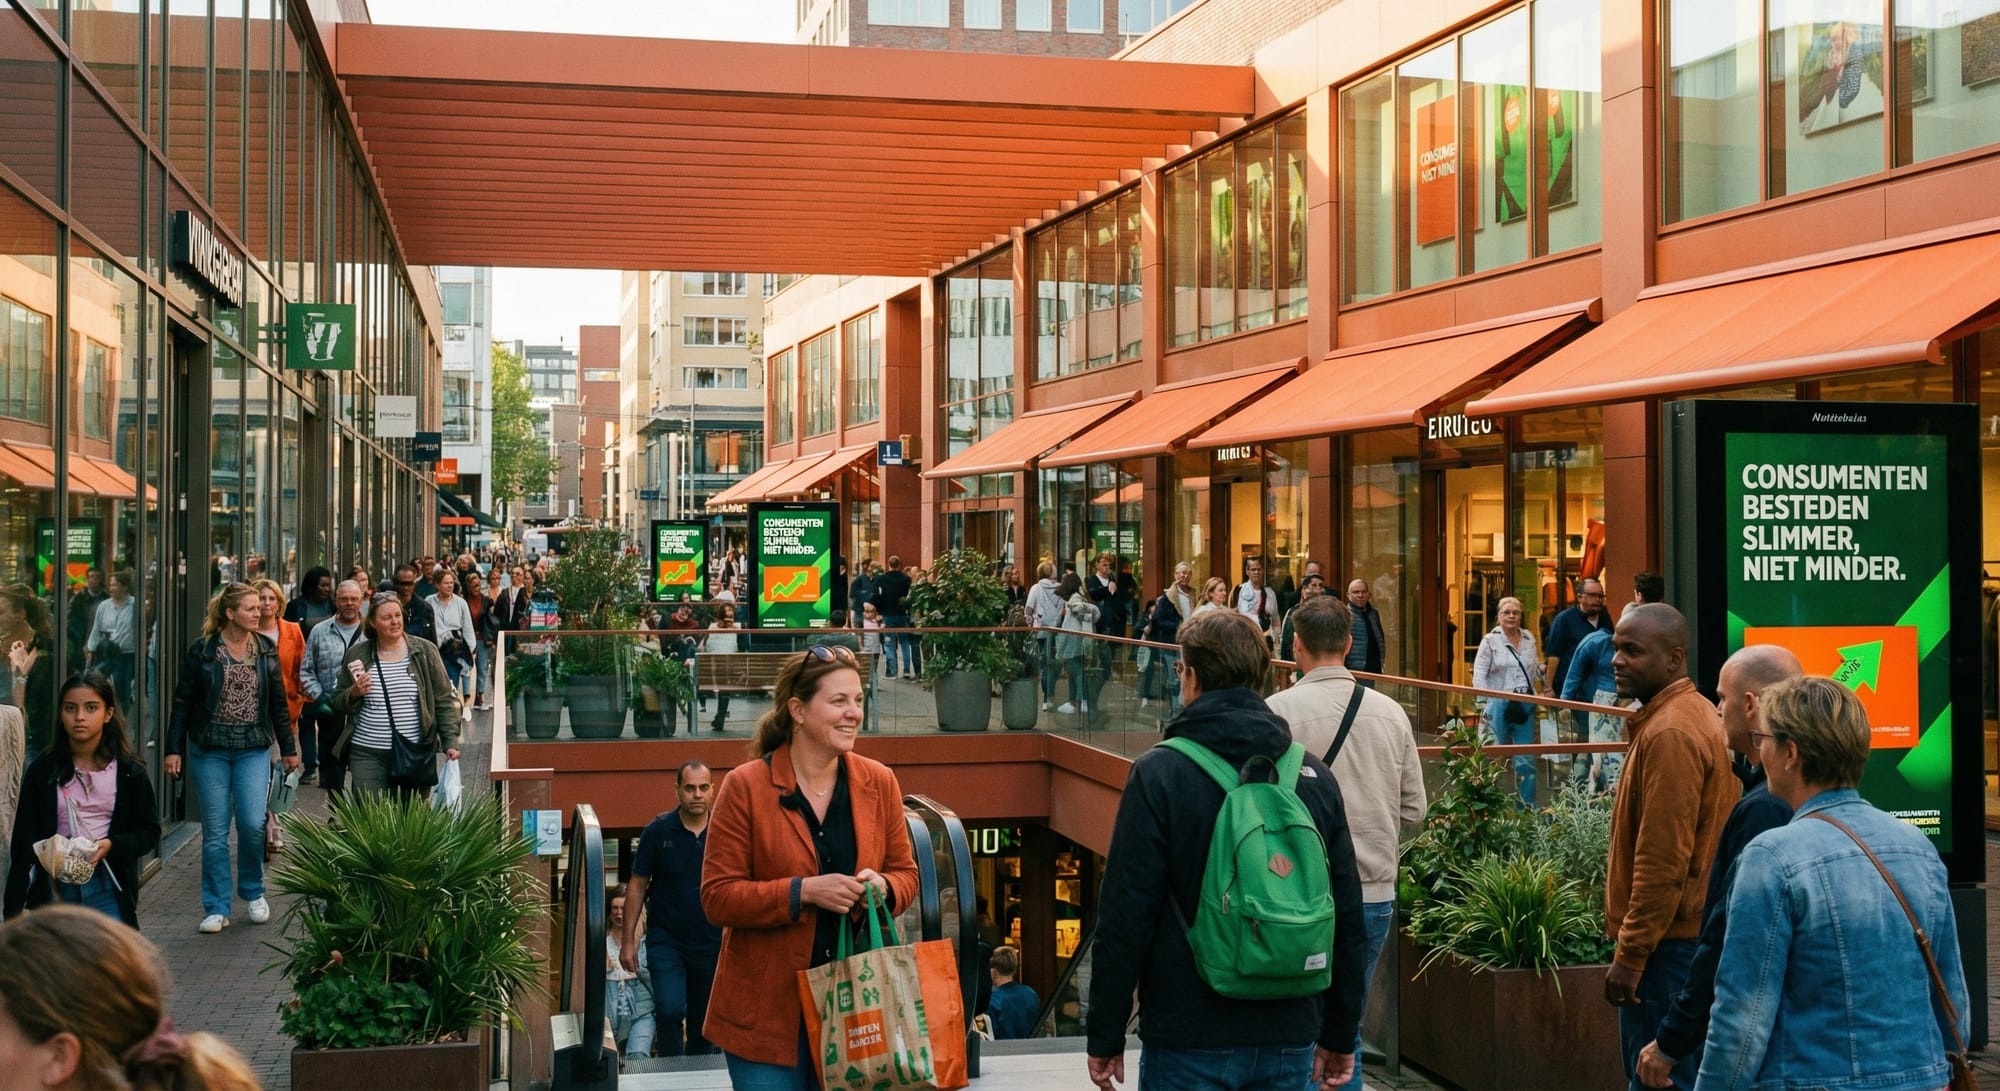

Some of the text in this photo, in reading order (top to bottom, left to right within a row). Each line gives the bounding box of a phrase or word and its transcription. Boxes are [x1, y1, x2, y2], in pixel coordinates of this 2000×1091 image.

[1742, 464, 1927, 490] CONSUMENTEN
[1743, 495, 1869, 520] BESTEDEN
[1742, 525, 1860, 555] SLIMMER,
[1743, 556, 1906, 581] NIET MINDER.
